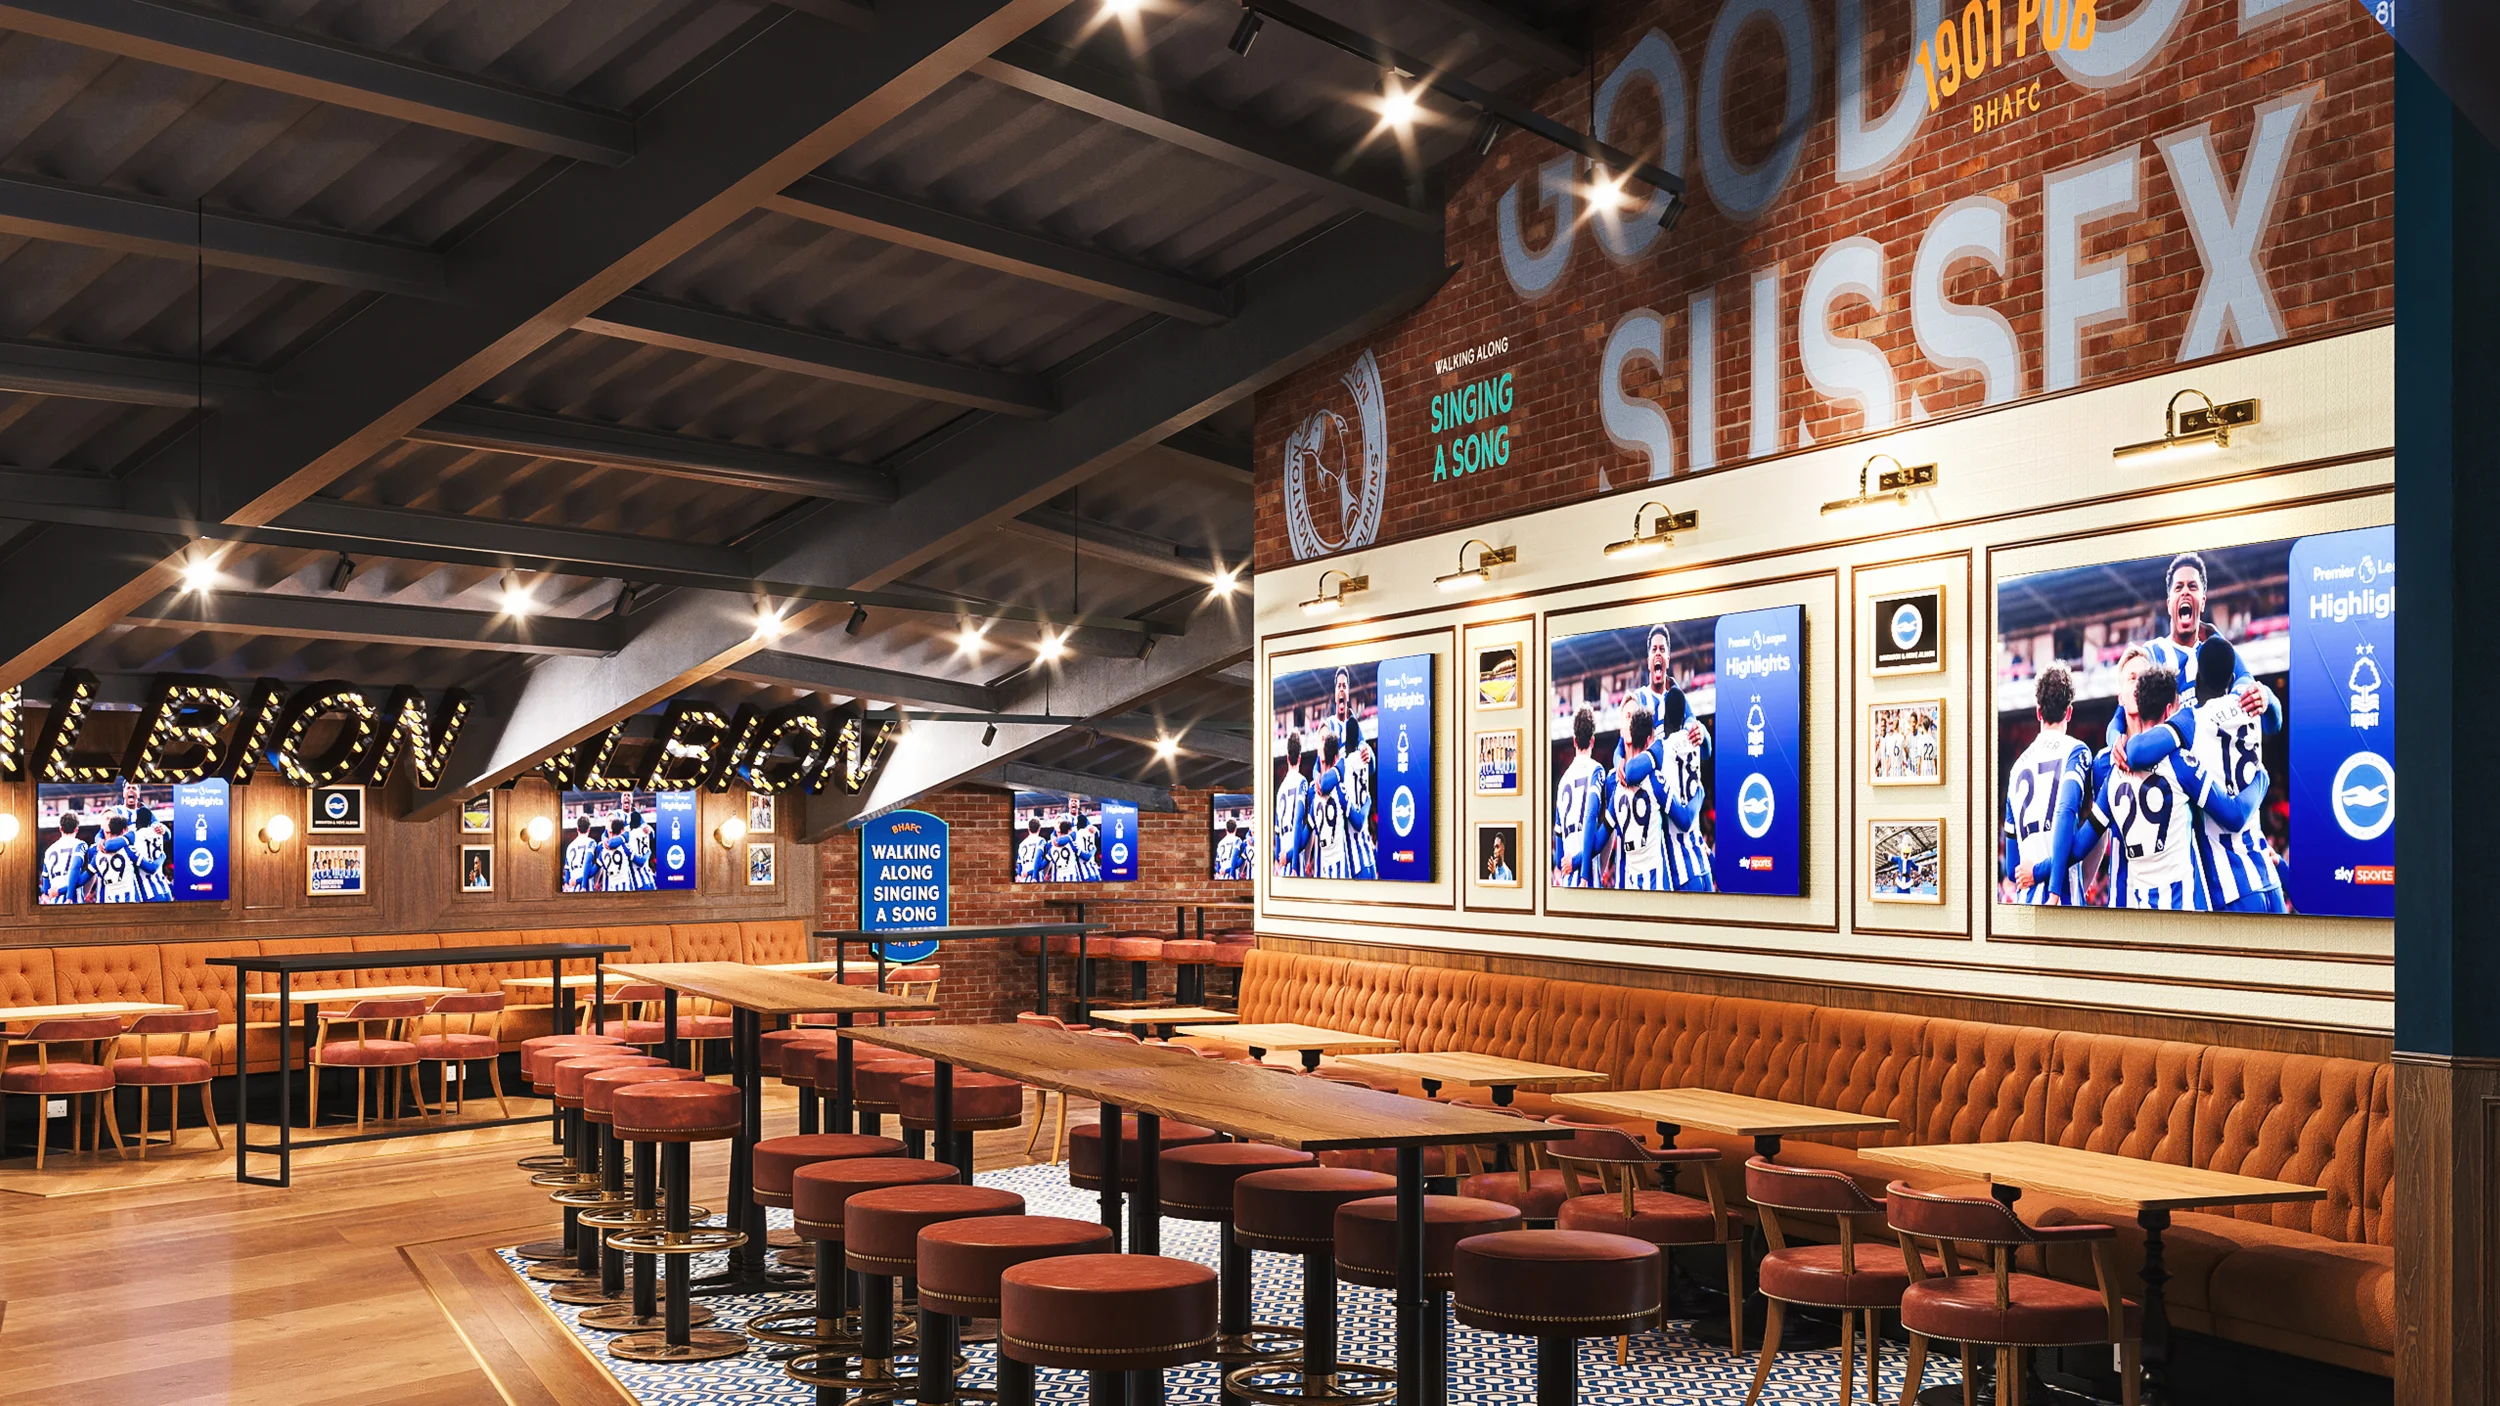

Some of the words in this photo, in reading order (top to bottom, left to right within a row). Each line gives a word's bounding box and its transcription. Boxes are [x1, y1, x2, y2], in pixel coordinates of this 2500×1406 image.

[1916, 0, 2002, 112] 1901
[2016, 0, 2097, 58] PUB
[1972, 81, 2041, 134] BHAFC
[1497, 0, 1946, 299] GOOD
[1434, 348, 1475, 375] WALKING
[1475, 336, 1509, 362] ALONG
[1430, 372, 1514, 434] SINGING
[1433, 443, 1448, 483] A
[1452, 424, 1510, 479] SONG
[2313, 563, 2356, 582] Premier
[1725, 652, 1791, 680] Highlights
[0, 682, 476, 791] LBION
[1922, 742, 1934, 761] 22
[2216, 722, 2260, 797] 18
[1675, 750, 1700, 805] 18
[1279, 786, 1297, 837] 27
[1561, 775, 1589, 839] 27
[2014, 757, 2064, 843] 27
[891, 822, 923, 835] BHAFC
[1315, 796, 1338, 848] 29
[1617, 786, 1651, 852] 29
[2113, 774, 2174, 859] 29
[48, 847, 73, 879] 27
[568, 845, 587, 871] 27
[603, 849, 623, 876] 29
[871, 843, 942, 860] WALKING
[1021, 842, 1037, 865] 27
[1052, 846, 1071, 869] 29
[1220, 842, 1234, 863] 27
[98, 853, 126, 885] 29
[879, 864, 933, 881] ALONG
[2334, 866, 2354, 884] sky
[2356, 868, 2394, 883] sports
[873, 885, 940, 902] SINGING
[875, 907, 887, 923] A
[891, 906, 937, 923] SONG
